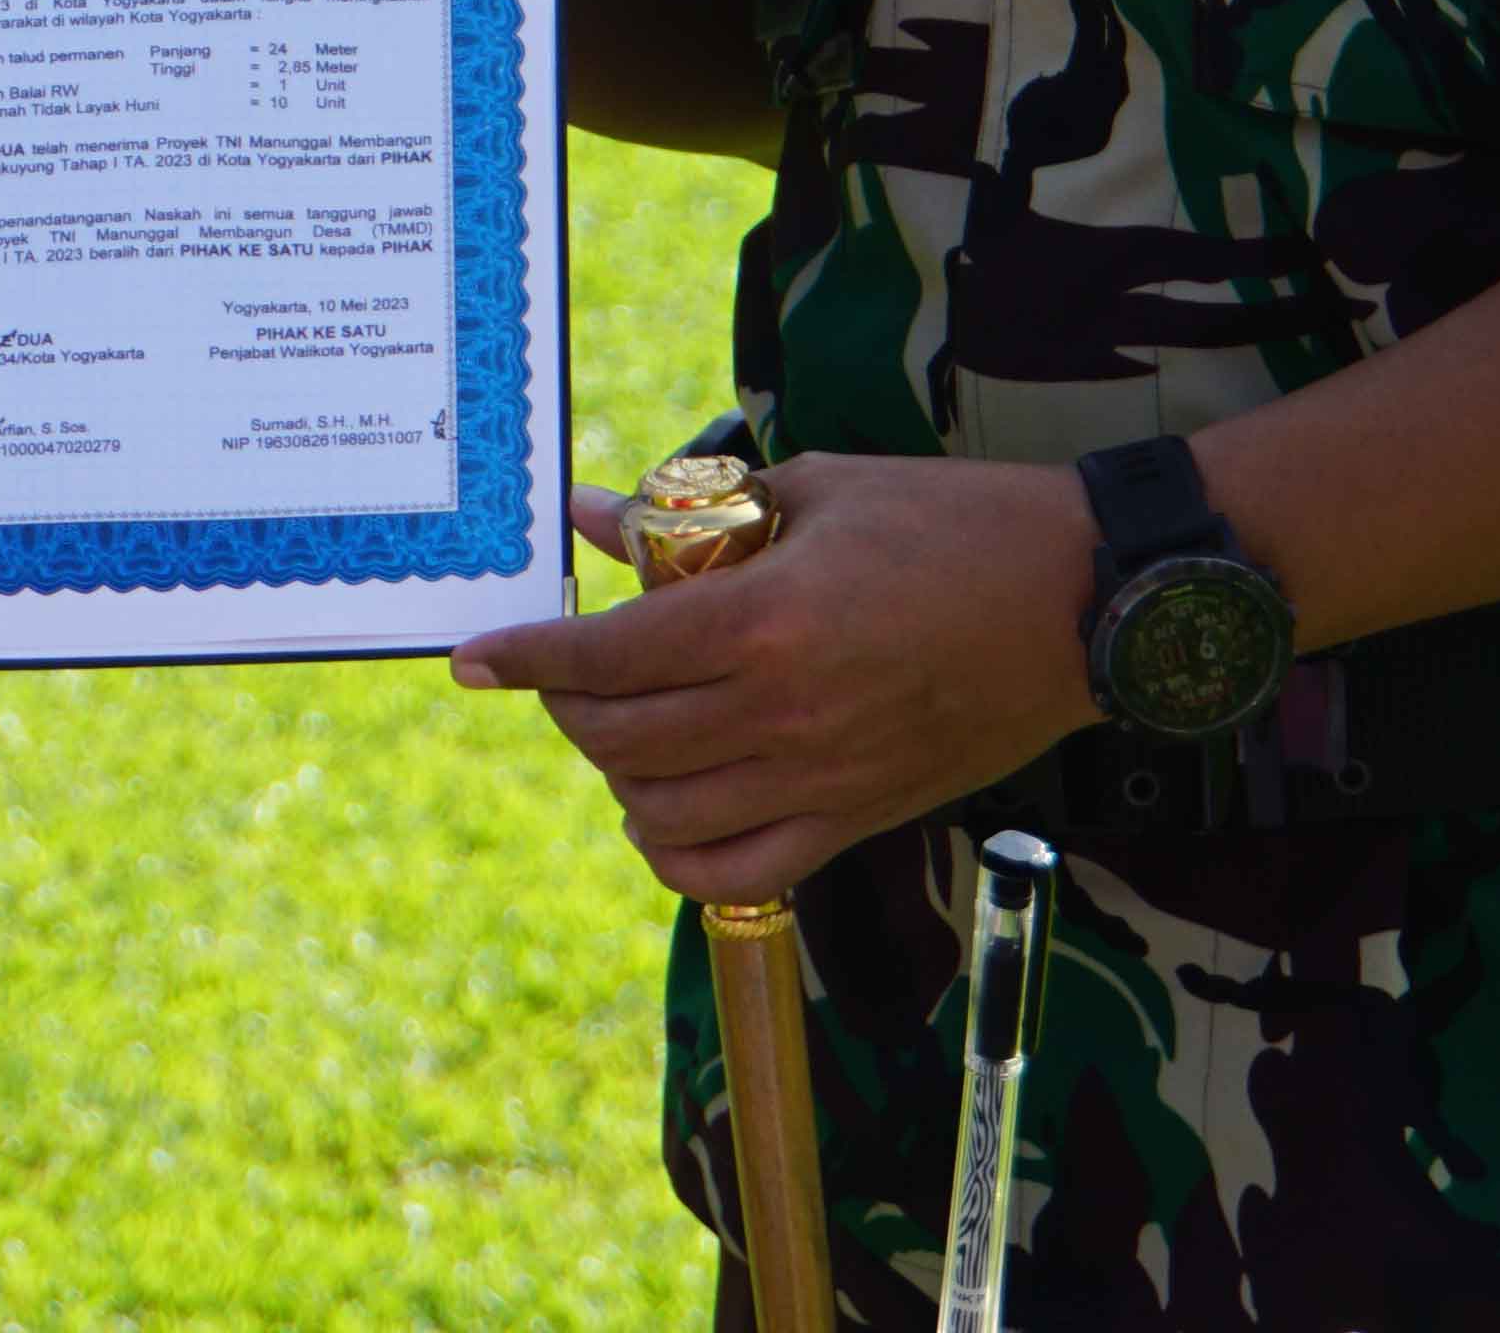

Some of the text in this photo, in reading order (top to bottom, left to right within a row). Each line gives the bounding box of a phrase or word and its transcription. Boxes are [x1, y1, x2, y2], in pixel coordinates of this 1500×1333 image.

[50, 13, 65, 27] di
[68, 12, 125, 28] wilayah
[128, 10, 164, 24] Kota
[168, 7, 252, 25] Yogyakarta
[319, 298, 336, 312] 10
[340, 297, 368, 312] Mei
[371, 297, 410, 311] 2023
[255, 323, 387, 340] PIHAK KE SATU
[208, 341, 434, 361] Penjabat Walikota Yogyakarta
[221, 436, 250, 450] NIP
